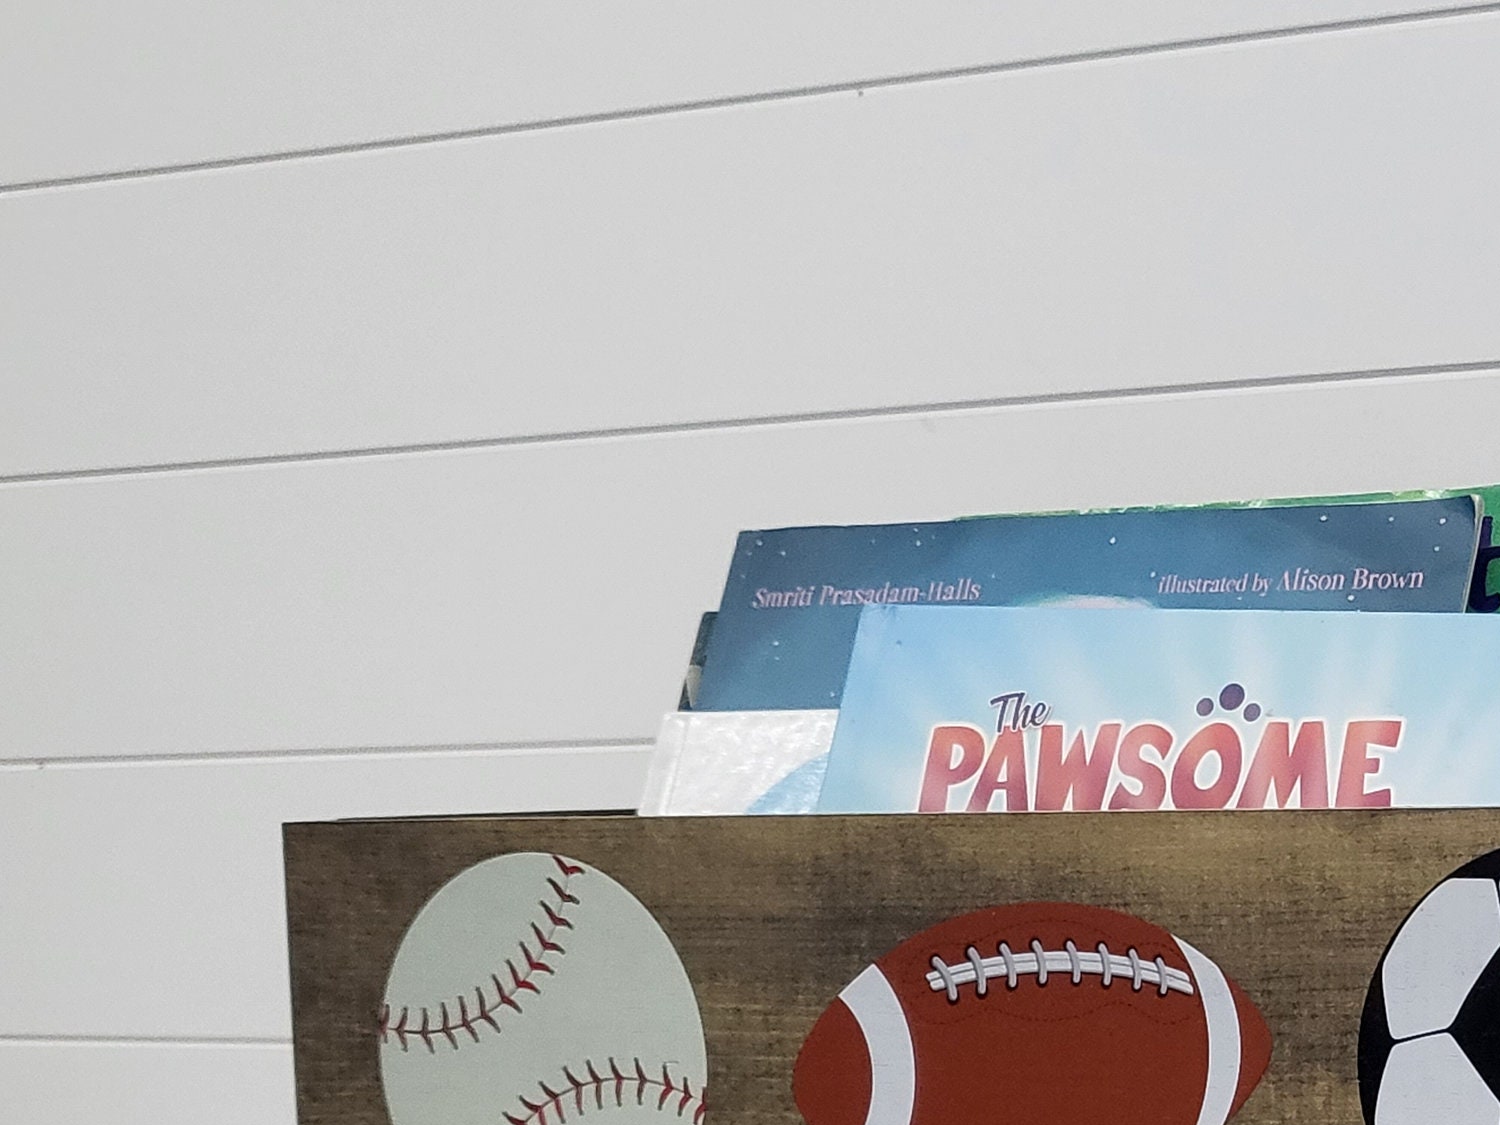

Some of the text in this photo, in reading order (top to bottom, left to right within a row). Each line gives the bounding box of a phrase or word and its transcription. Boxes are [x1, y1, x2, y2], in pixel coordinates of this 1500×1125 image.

[752, 577, 981, 609] Smriti Prasadam-Halls
[1157, 567, 1425, 597] illustrated by Alison Brown
[989, 690, 1052, 735] The
[916, 719, 1403, 813] PAWSOME
